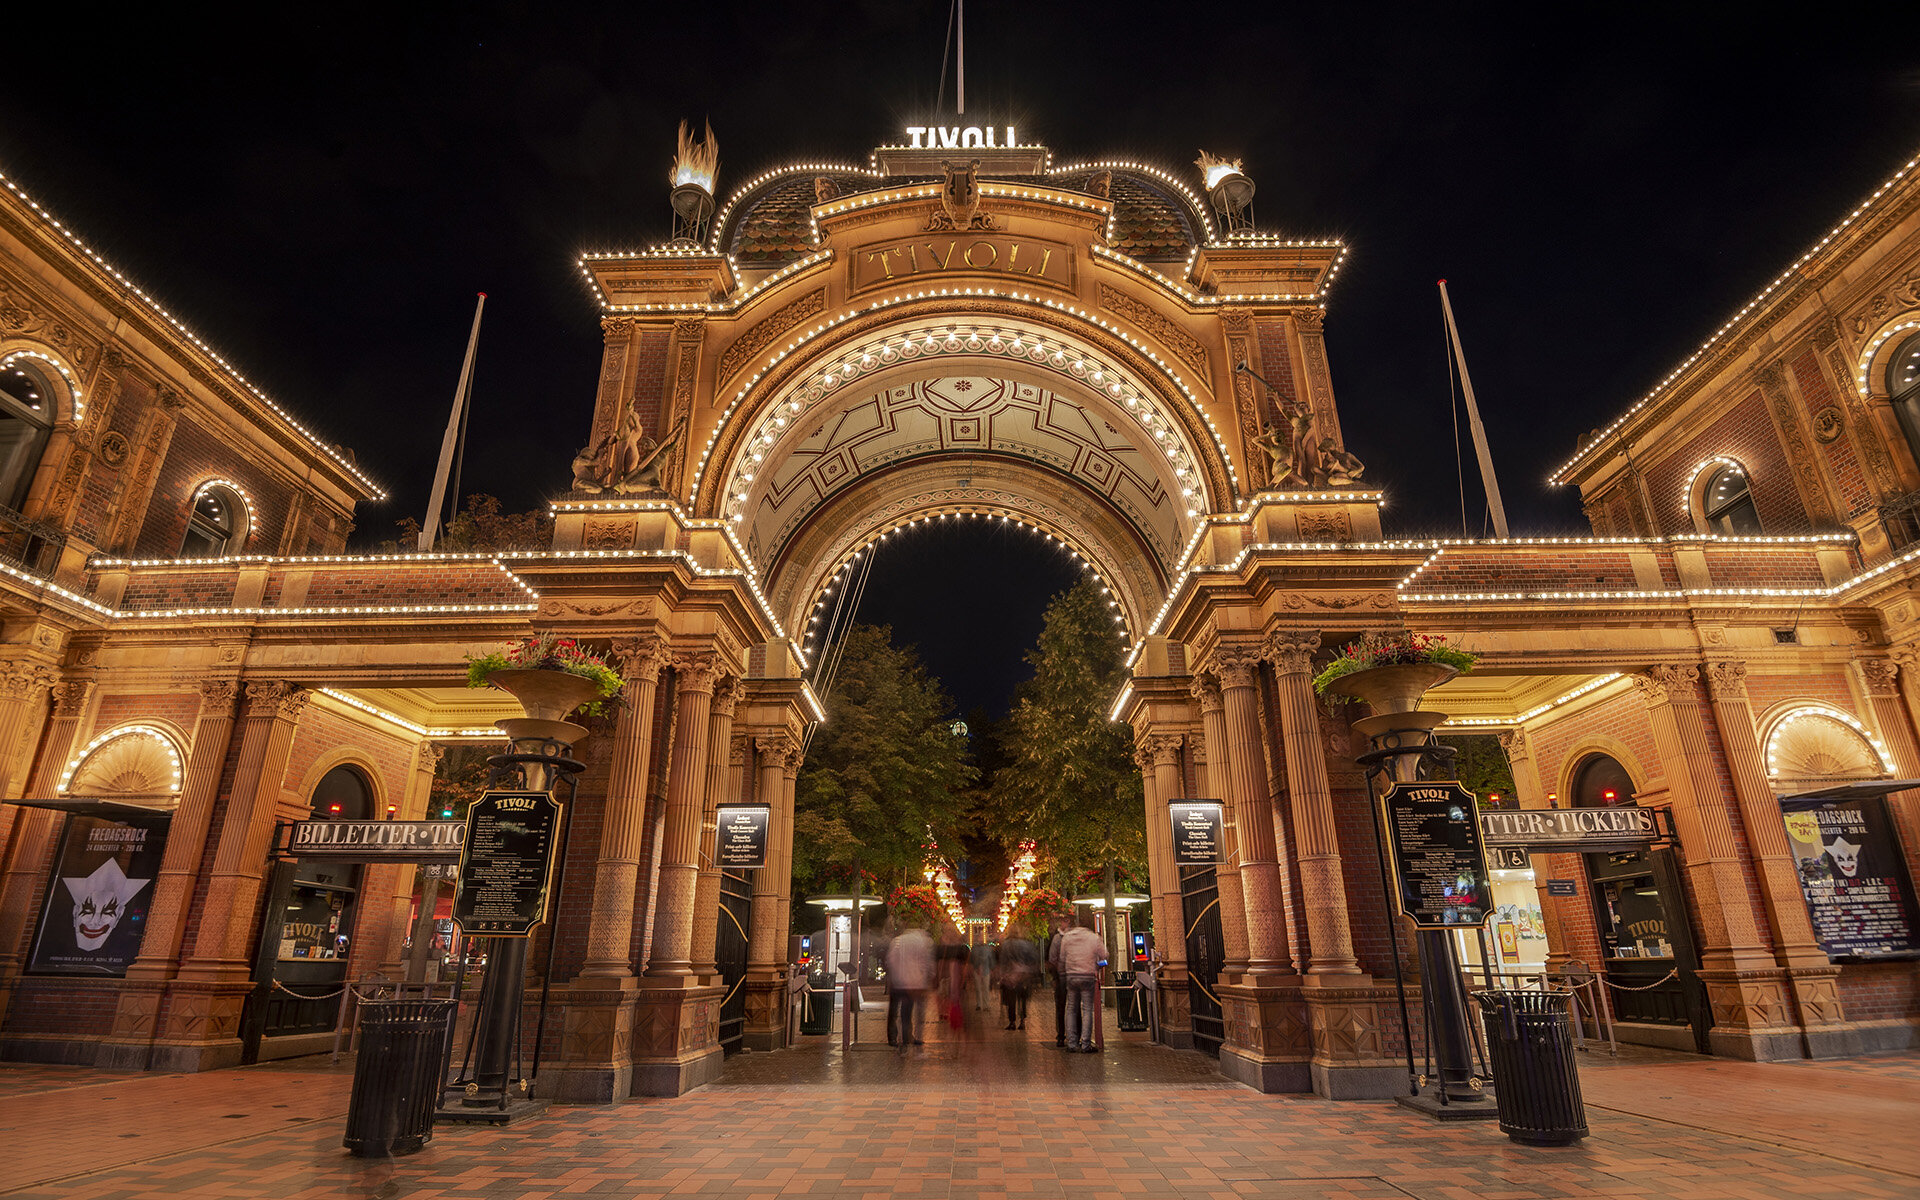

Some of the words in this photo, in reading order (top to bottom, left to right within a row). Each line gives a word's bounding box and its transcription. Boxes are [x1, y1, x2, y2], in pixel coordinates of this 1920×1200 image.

[906, 126, 1015, 148] TIVOLI
[867, 241, 1052, 279] TIVOLI
[495, 798, 537, 810] TIVOLI
[1408, 789, 1450, 801] TIVOLI
[1482, 814, 1545, 834] TTER
[1555, 811, 1651, 834] TICKETS
[90, 828, 148, 841] FREDAGSROCK
[296, 824, 416, 844] BILLETTER
[431, 824, 466, 844] TIC
[1628, 920, 1667, 938] TIVOL
